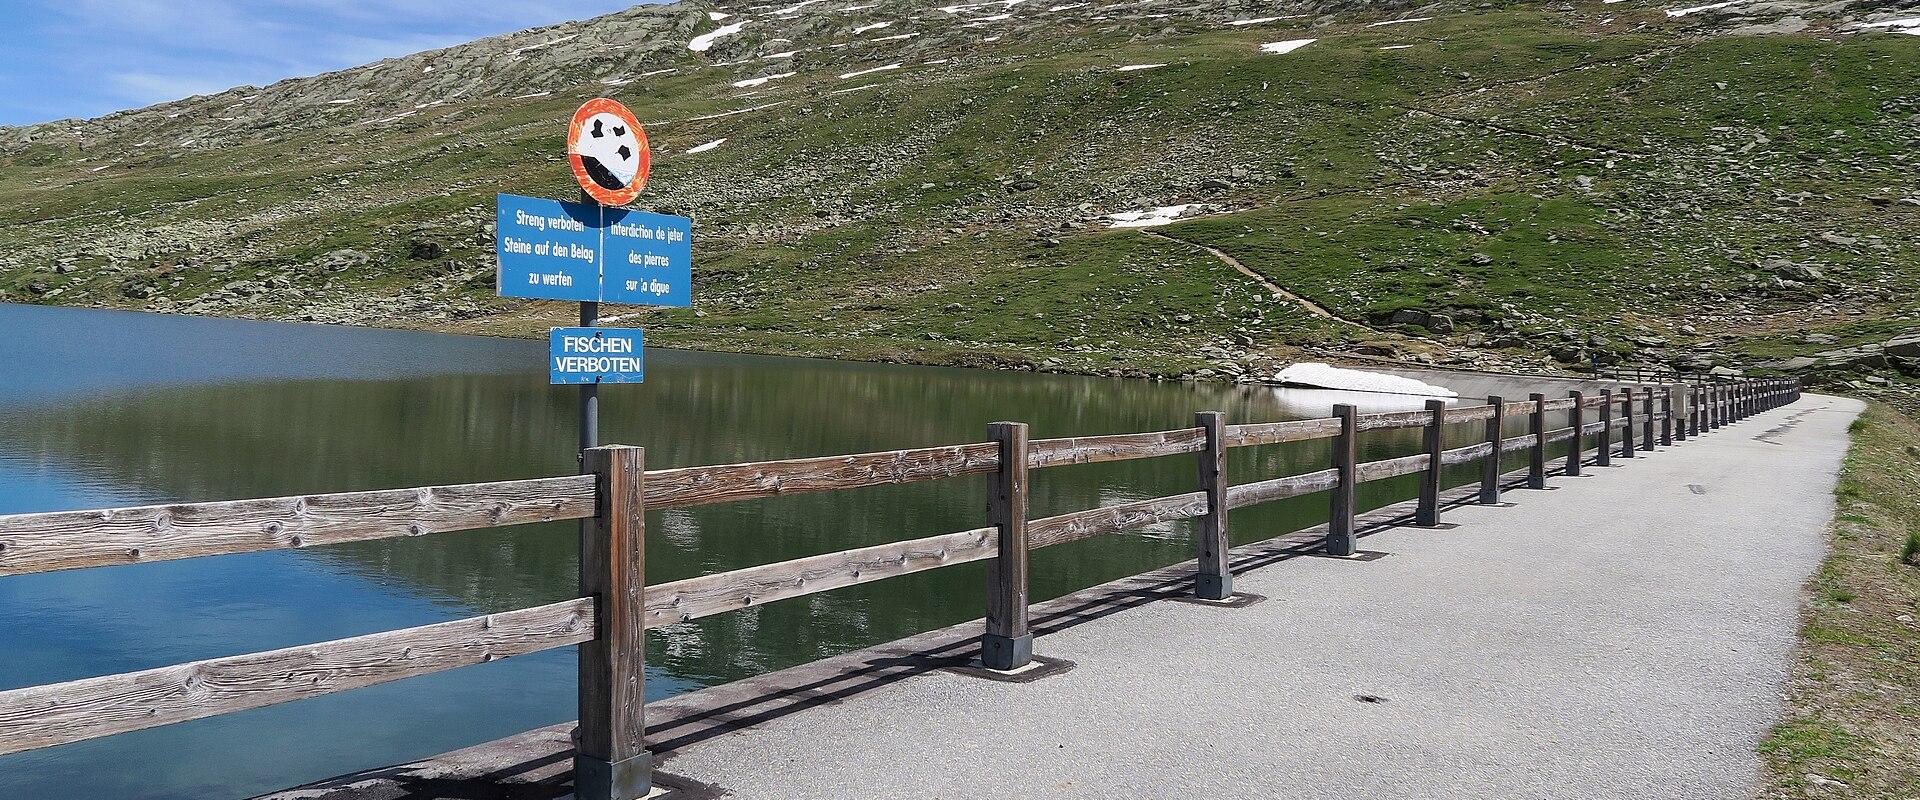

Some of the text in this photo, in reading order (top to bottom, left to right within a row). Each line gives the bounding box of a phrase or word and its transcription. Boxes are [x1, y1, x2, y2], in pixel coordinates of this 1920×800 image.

[516, 209, 585, 232] Streng verboten
[655, 225, 666, 240] de
[667, 227, 684, 244] jeter
[504, 236, 594, 263] Steine auf den Belag
[628, 250, 669, 268] des pierres
[528, 270, 572, 287] zu werfen
[625, 279, 638, 291] sur
[650, 278, 670, 296] digue
[564, 336, 632, 353] FISCHEN
[555, 356, 641, 373] VERBOTEN
